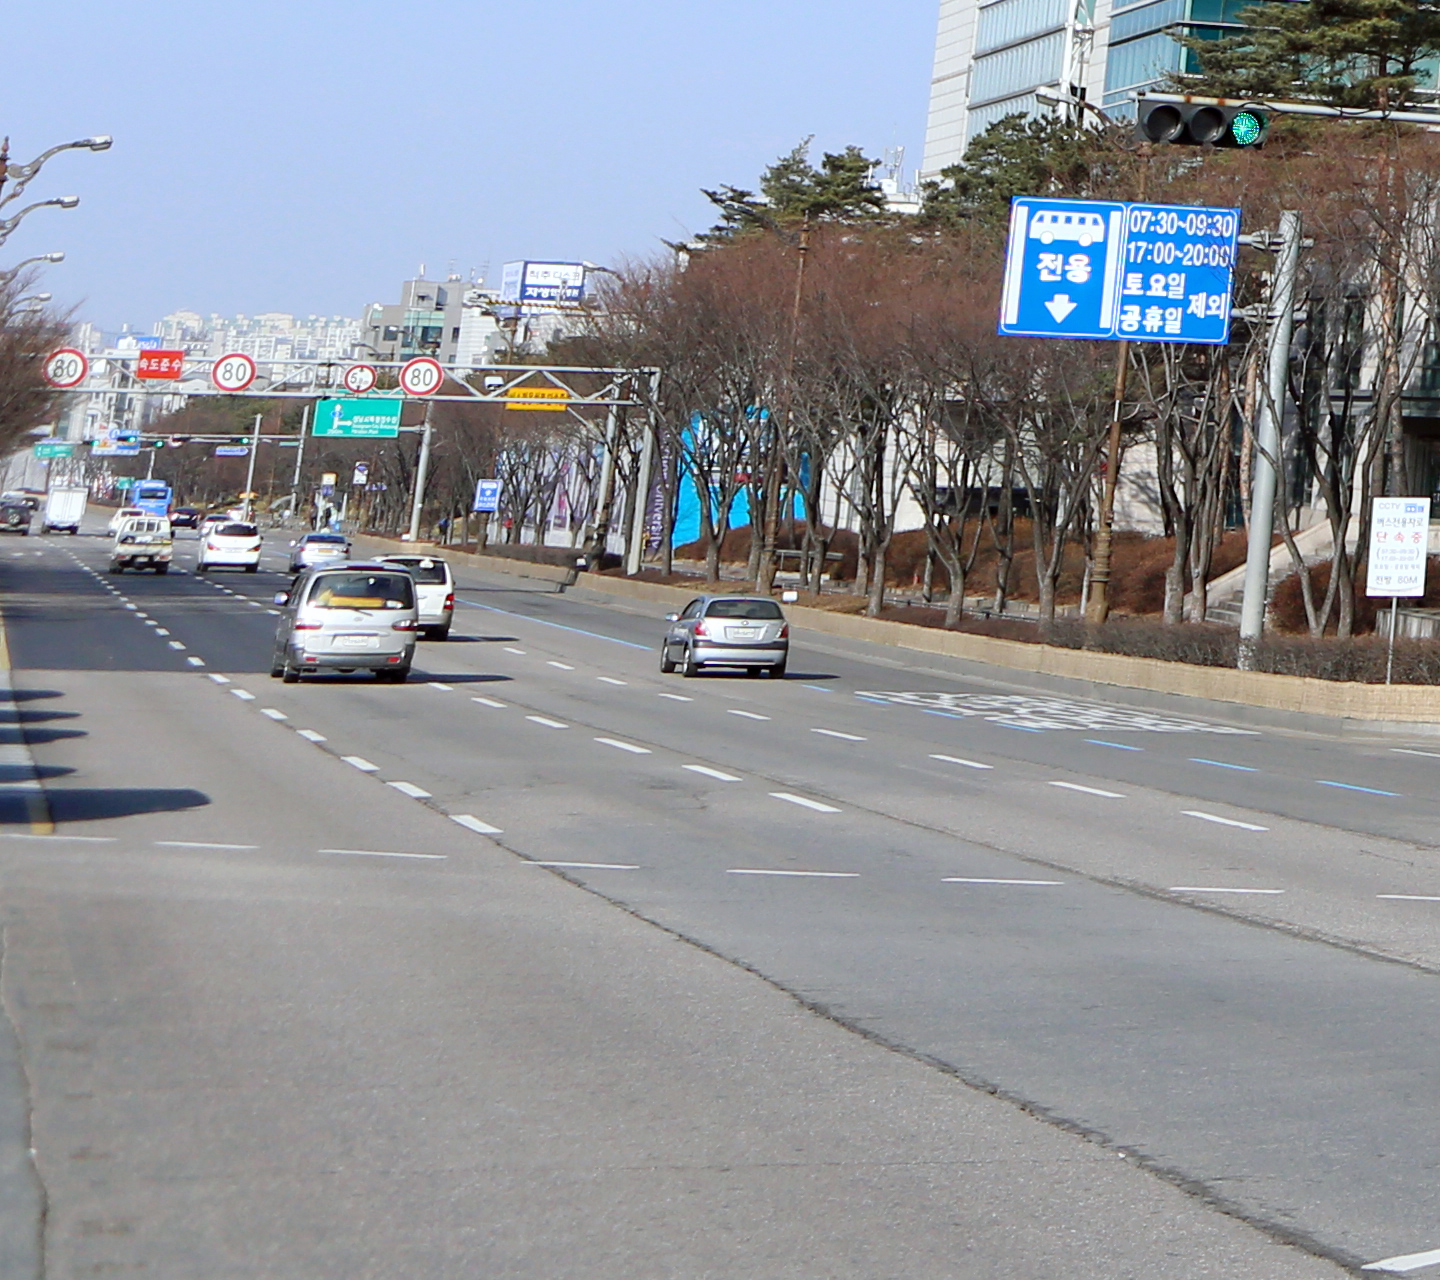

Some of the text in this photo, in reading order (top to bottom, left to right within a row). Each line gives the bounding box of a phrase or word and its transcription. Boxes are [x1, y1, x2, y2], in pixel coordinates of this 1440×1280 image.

[1130, 209, 1233, 238] 07:30~09:30
[1035, 252, 1092, 284] 전용
[1127, 240, 1230, 268] 17:00~20:00
[1122, 272, 1187, 300] 토요일
[1119, 304, 1183, 335] 공휴일
[1186, 291, 1227, 320] 제외
[53, 358, 78, 379] 80
[139, 357, 182, 373] 속도준수
[222, 362, 247, 382] 80
[410, 368, 434, 386] 80
[1378, 502, 1401, 510] CCTV
